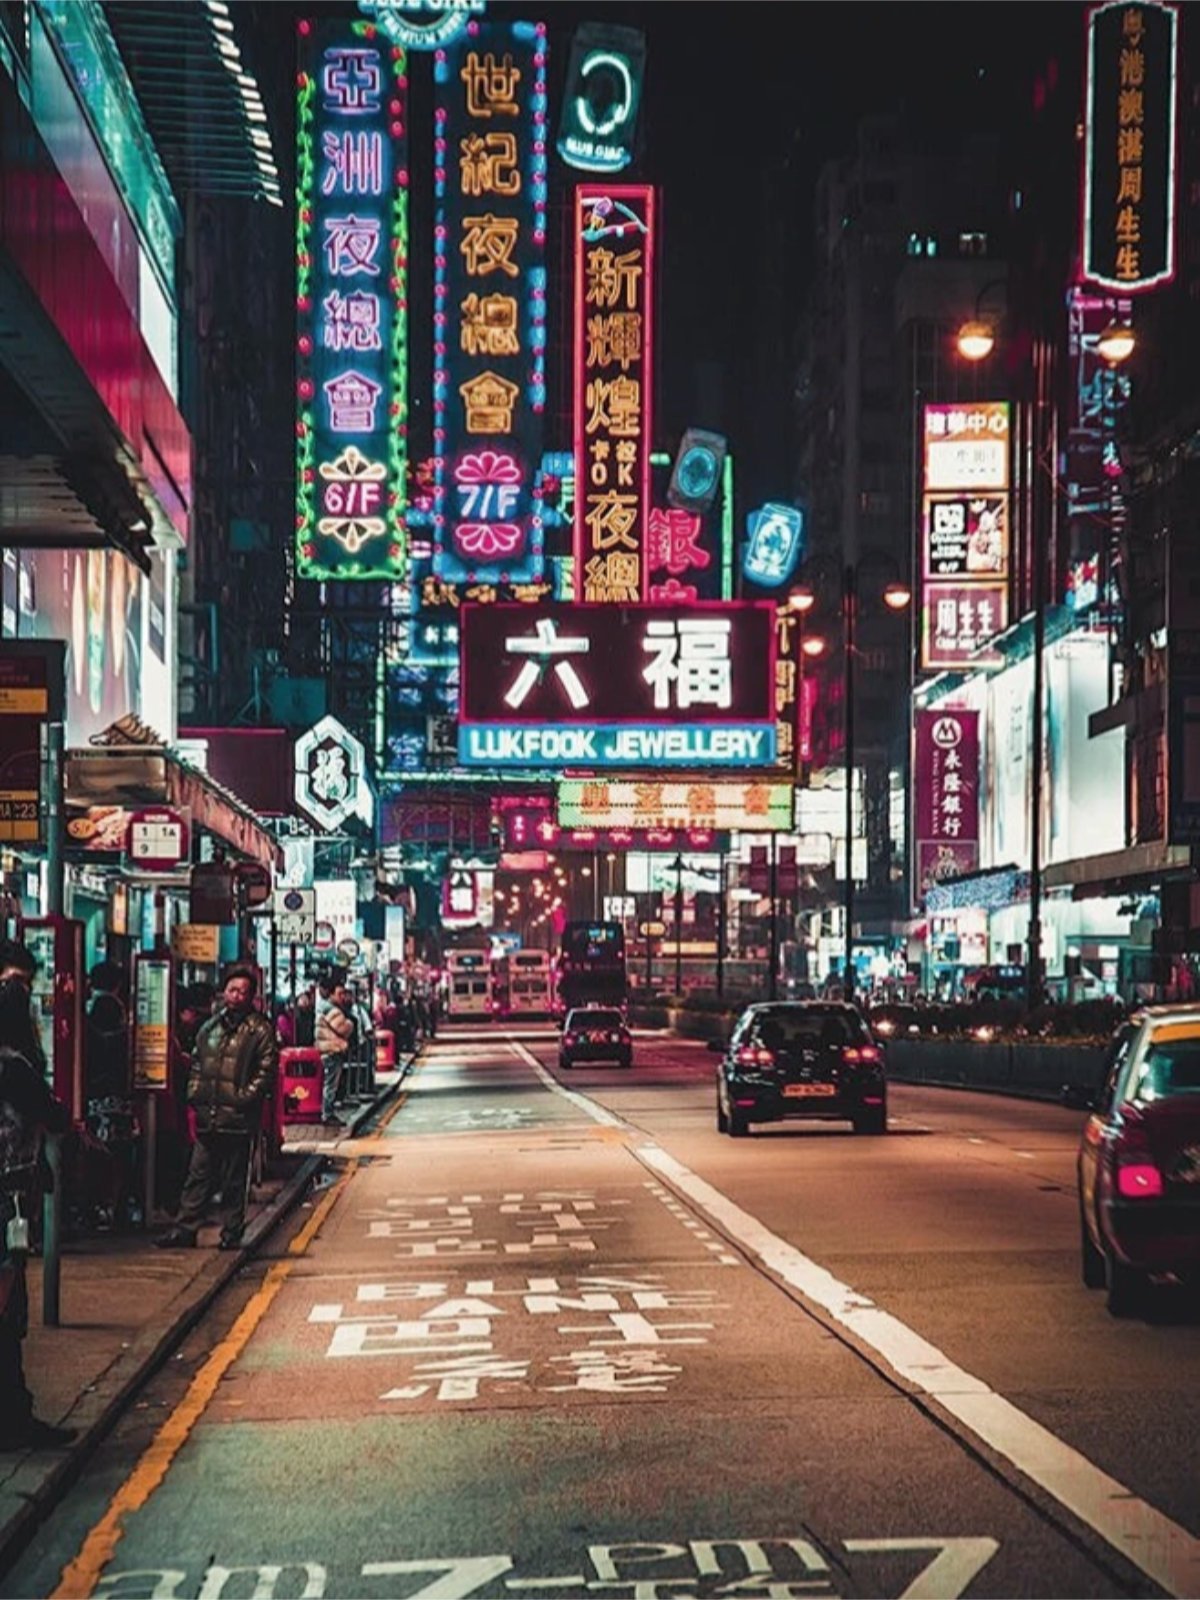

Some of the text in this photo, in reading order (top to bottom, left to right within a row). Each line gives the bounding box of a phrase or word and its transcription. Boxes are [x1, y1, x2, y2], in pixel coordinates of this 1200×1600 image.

[323, 48, 382, 432] 亞洲夜總會
[460, 52, 521, 433] 世紀夜總會
[324, 483, 381, 514] 6/F
[457, 484, 520, 519] 7/F
[504, 618, 732, 710] 六福
[470, 730, 764, 761] LUKFOOK JEWELLERY
[142, 827, 148, 837] 1
